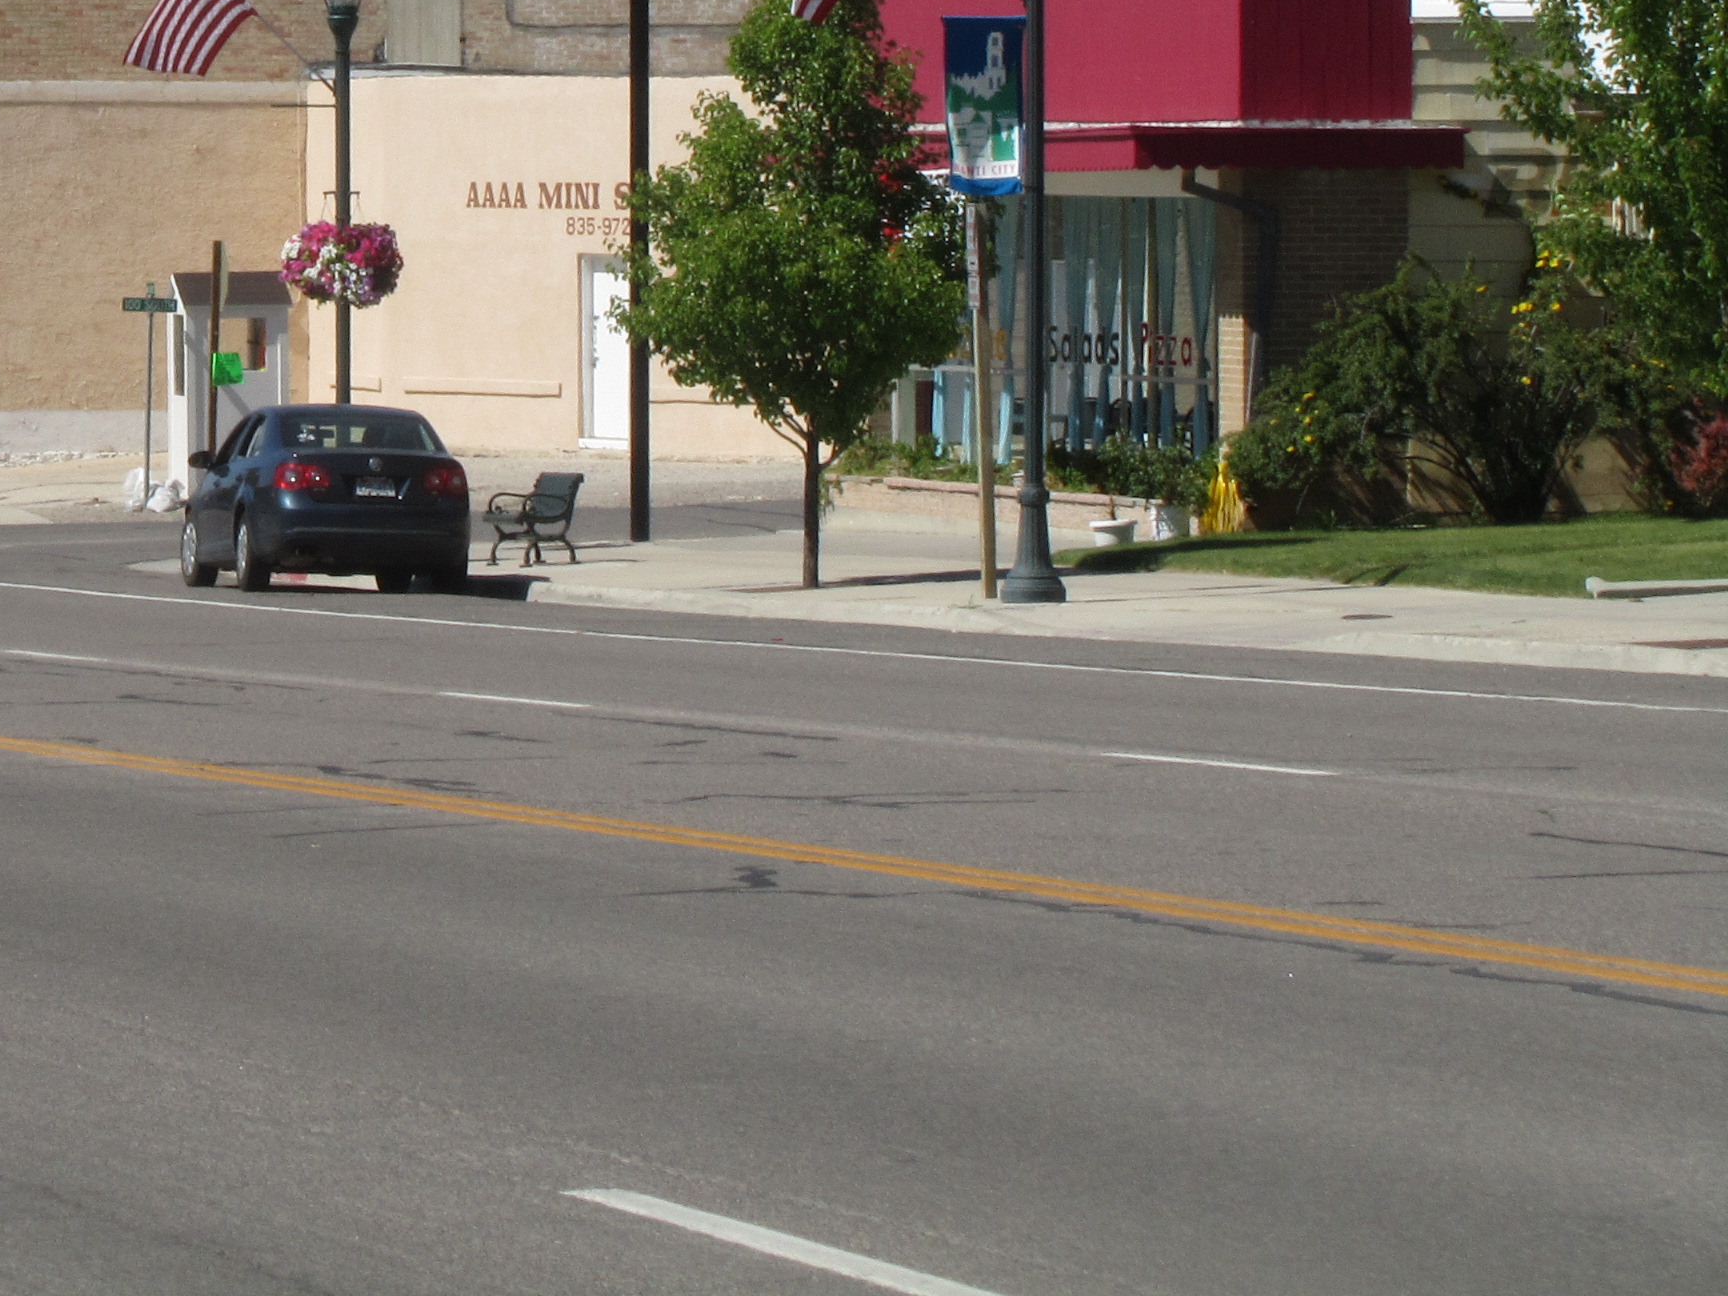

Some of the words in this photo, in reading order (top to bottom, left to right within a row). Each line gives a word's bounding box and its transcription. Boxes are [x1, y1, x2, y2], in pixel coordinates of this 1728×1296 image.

[991, 164, 1016, 175] CITY
[466, 181, 527, 209] AAAA
[538, 182, 600, 210] MINI
[565, 216, 631, 236] 835-972
[1048, 326, 1120, 365] Salads
[1140, 322, 1192, 365] Pizza
